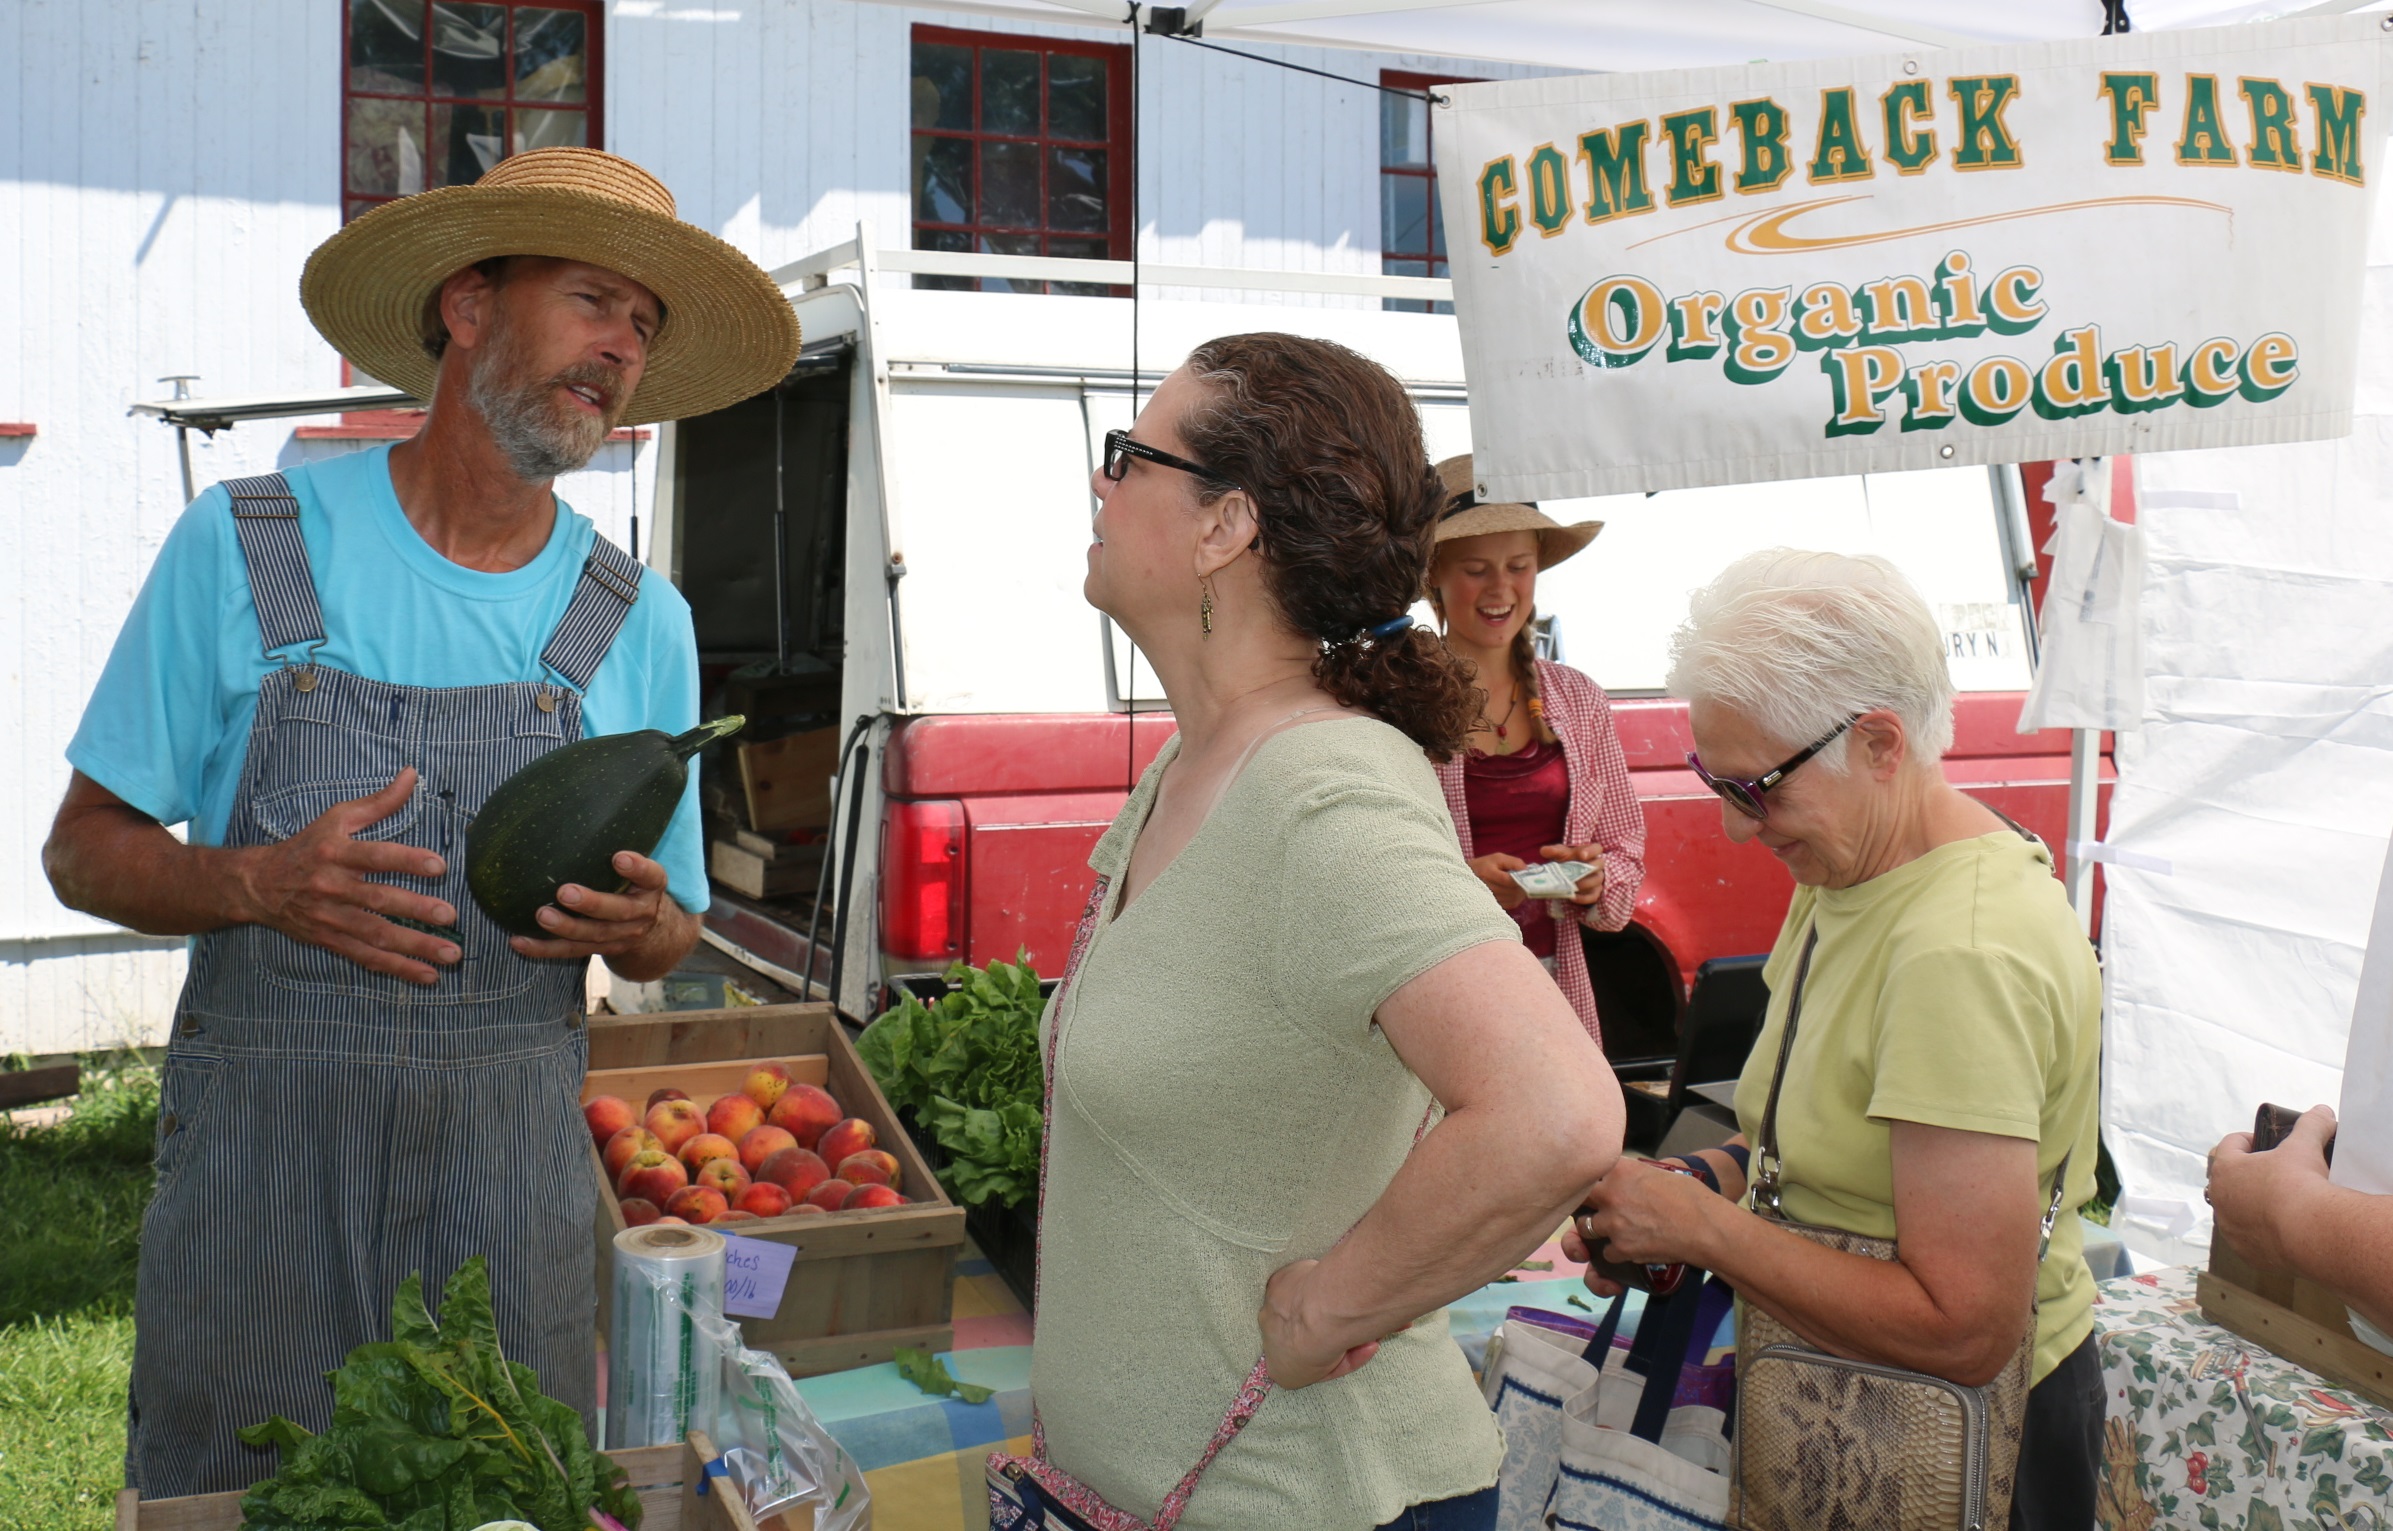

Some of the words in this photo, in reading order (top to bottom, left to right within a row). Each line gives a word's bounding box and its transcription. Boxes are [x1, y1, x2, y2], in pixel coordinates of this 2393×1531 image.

[1475, 73, 2024, 257] COMEBACK
[2099, 71, 2367, 187] FARM
[1569, 250, 2049, 385] Organic
[1824, 324, 2300, 438] Produce
[725, 1249, 759, 1271] ches
